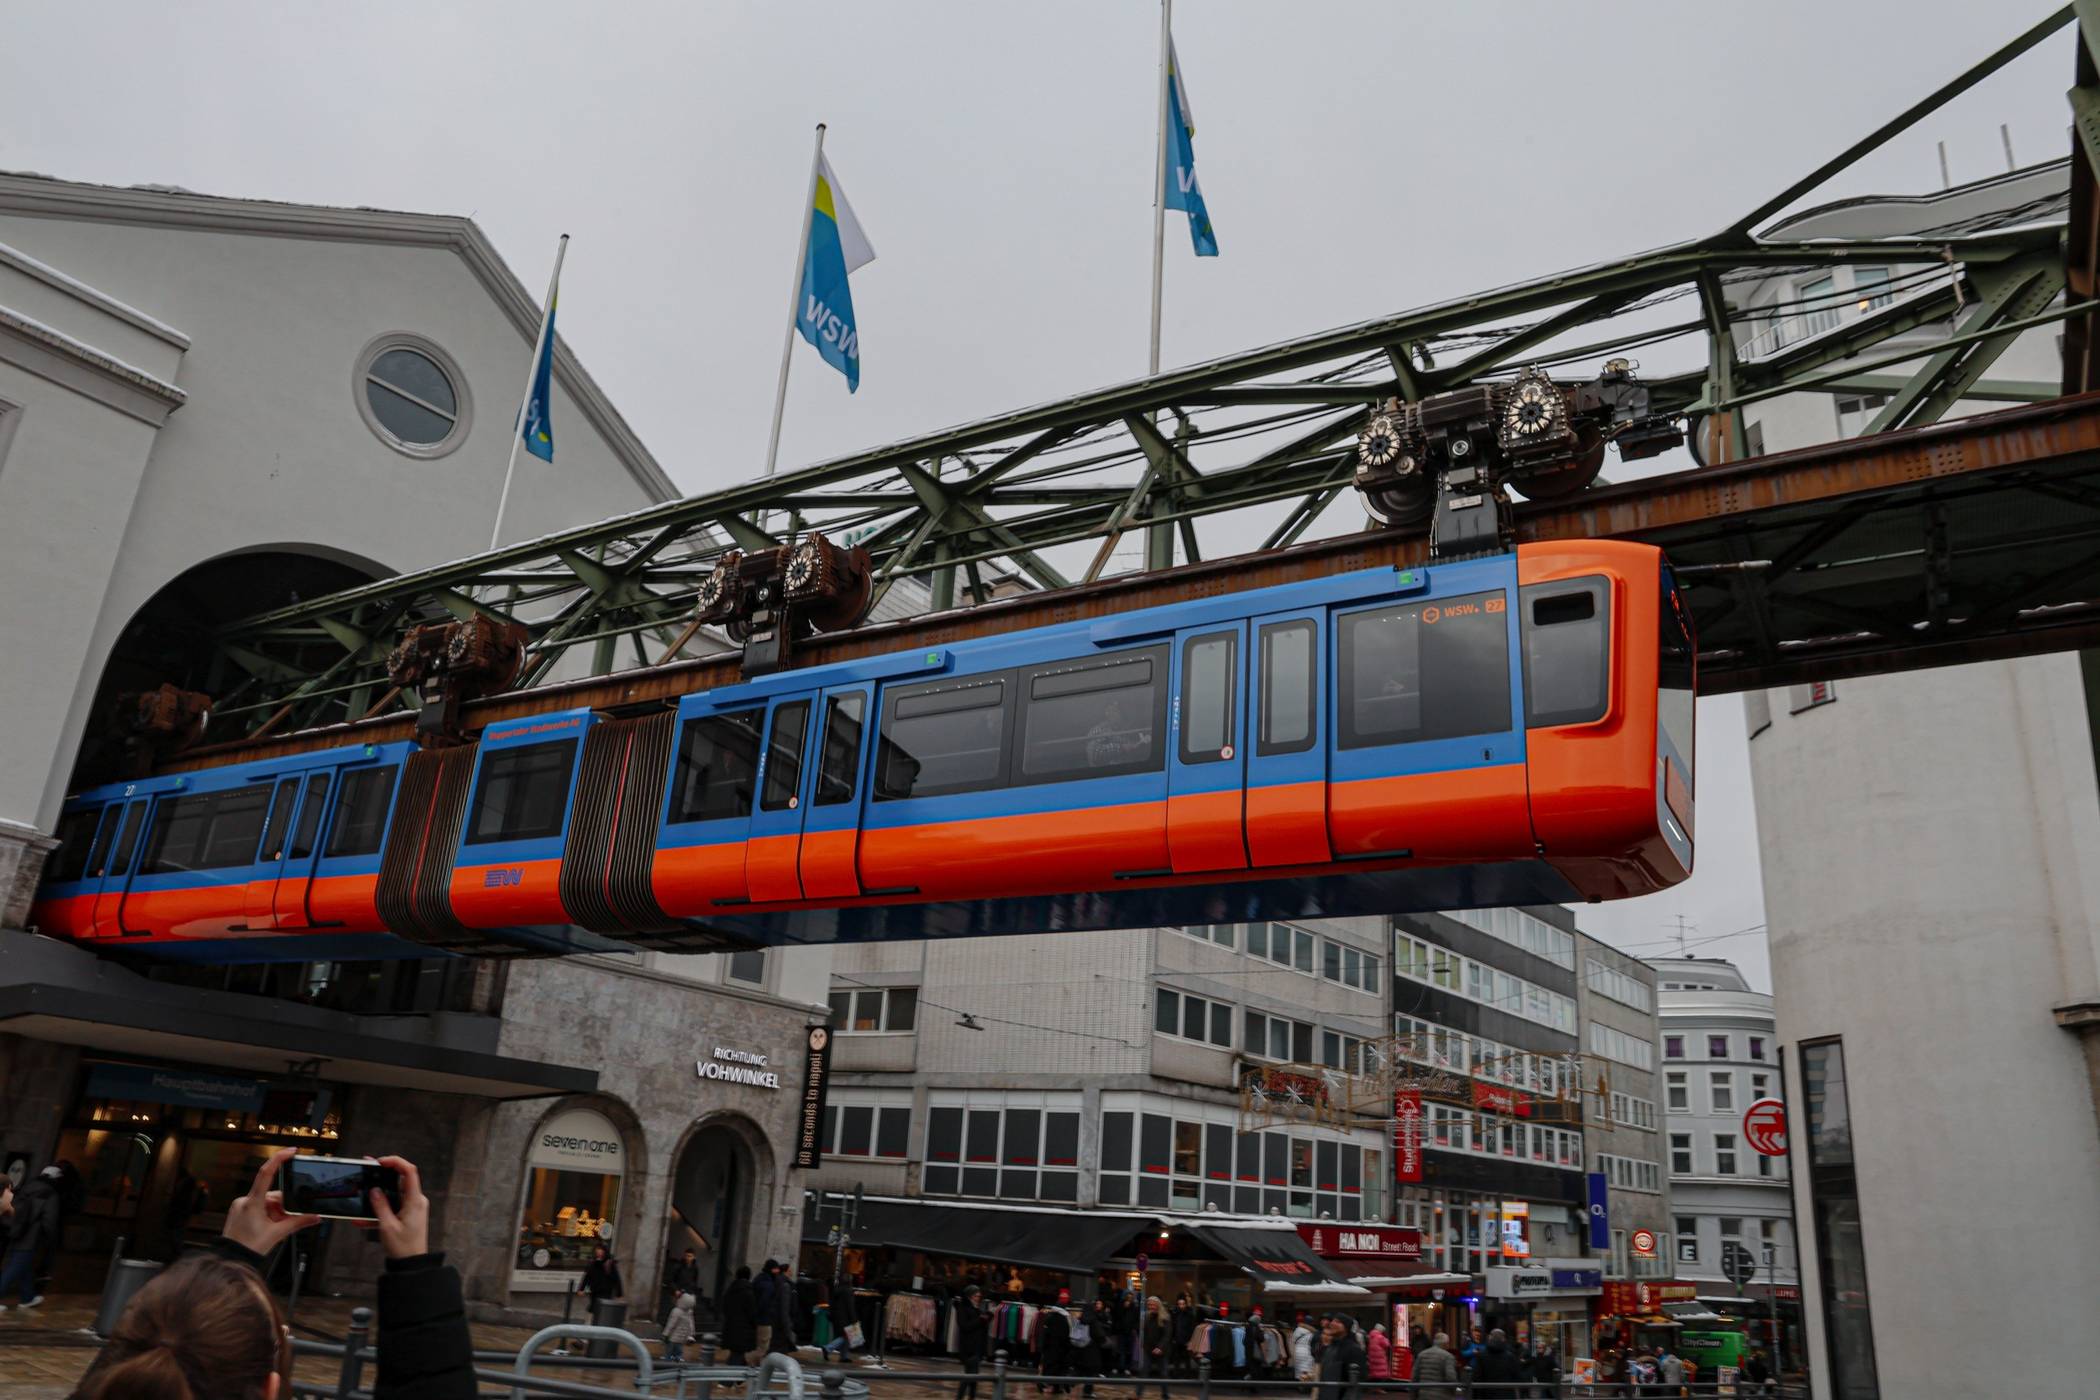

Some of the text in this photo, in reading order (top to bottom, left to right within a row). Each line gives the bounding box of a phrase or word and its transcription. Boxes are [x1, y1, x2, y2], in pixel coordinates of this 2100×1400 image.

[806, 294, 859, 359] WSW
[1486, 601, 1504, 613] 27
[713, 1047, 768, 1066] RICHTUNG
[696, 1061, 780, 1088] VOHWINKEL
